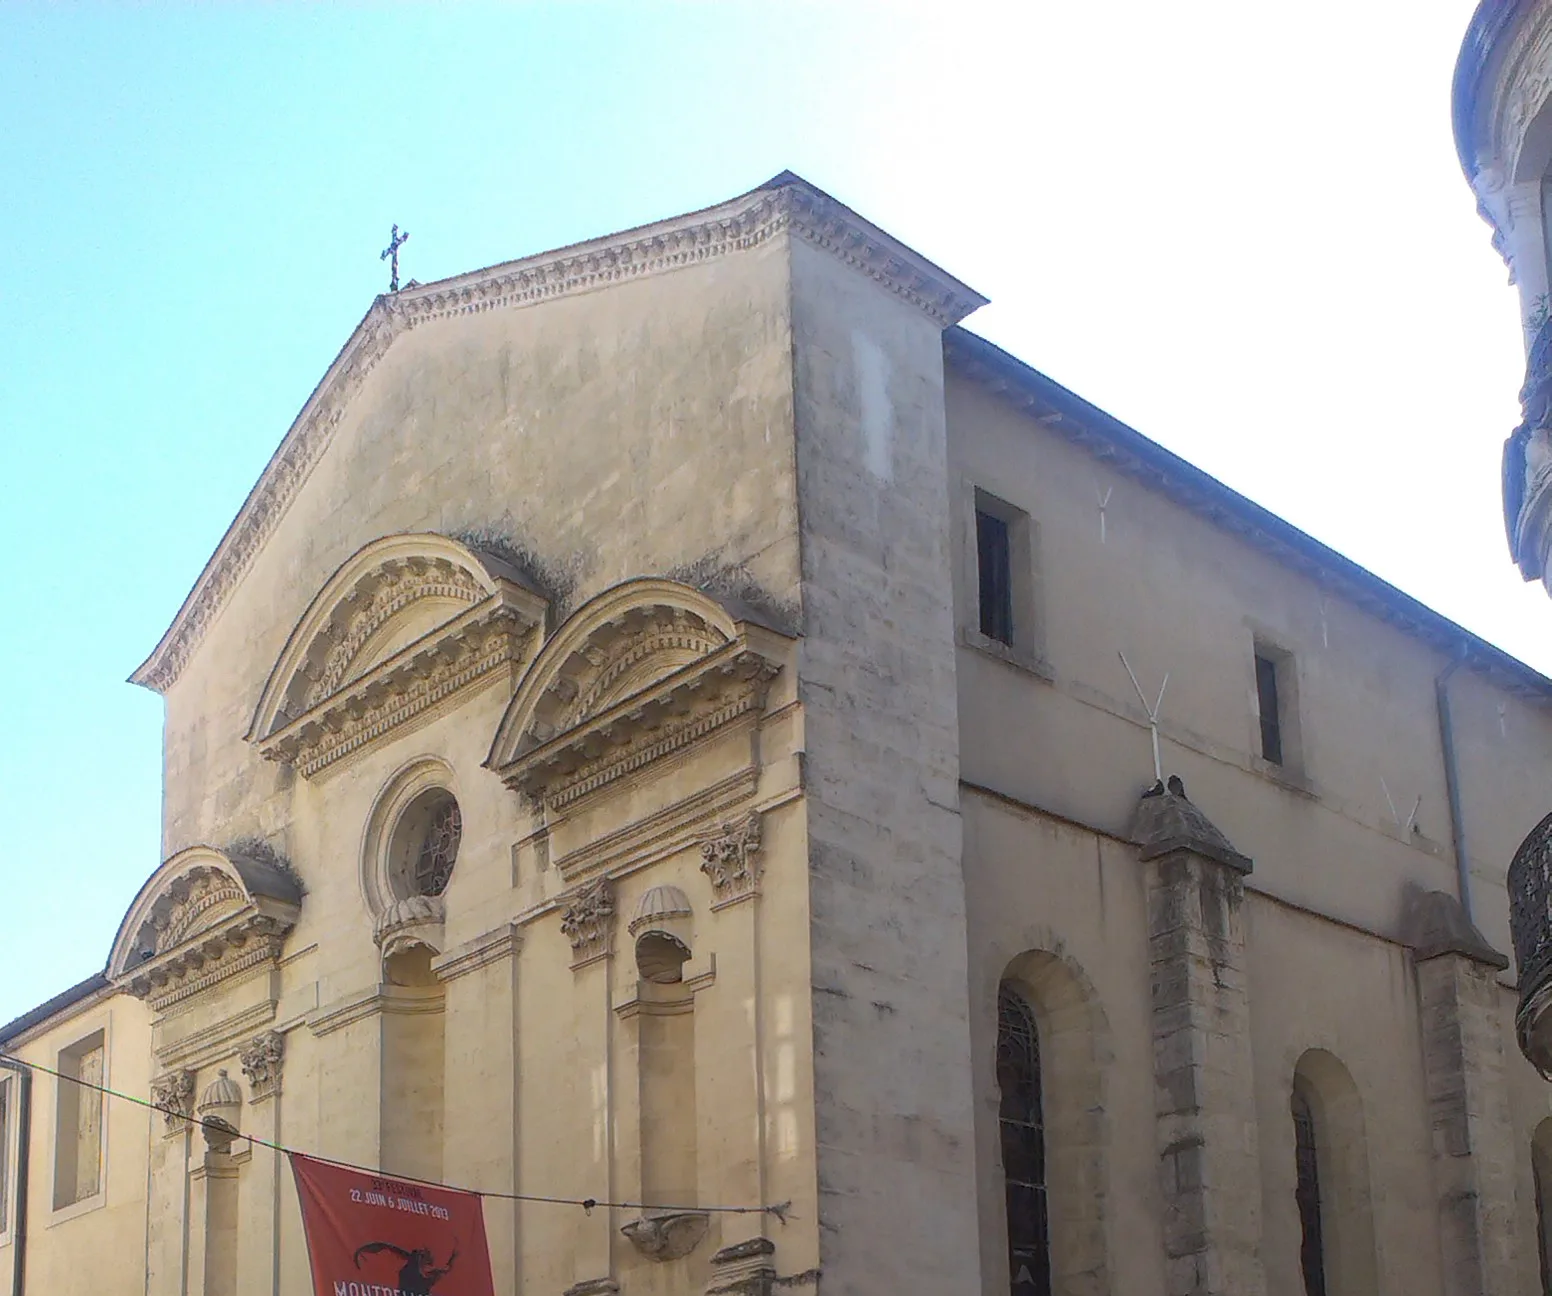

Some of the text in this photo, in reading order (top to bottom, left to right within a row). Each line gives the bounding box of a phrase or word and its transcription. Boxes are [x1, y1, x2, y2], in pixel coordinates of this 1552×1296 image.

[349, 1188, 449, 1222] 22 JUIN 6 JUILLET 2013
